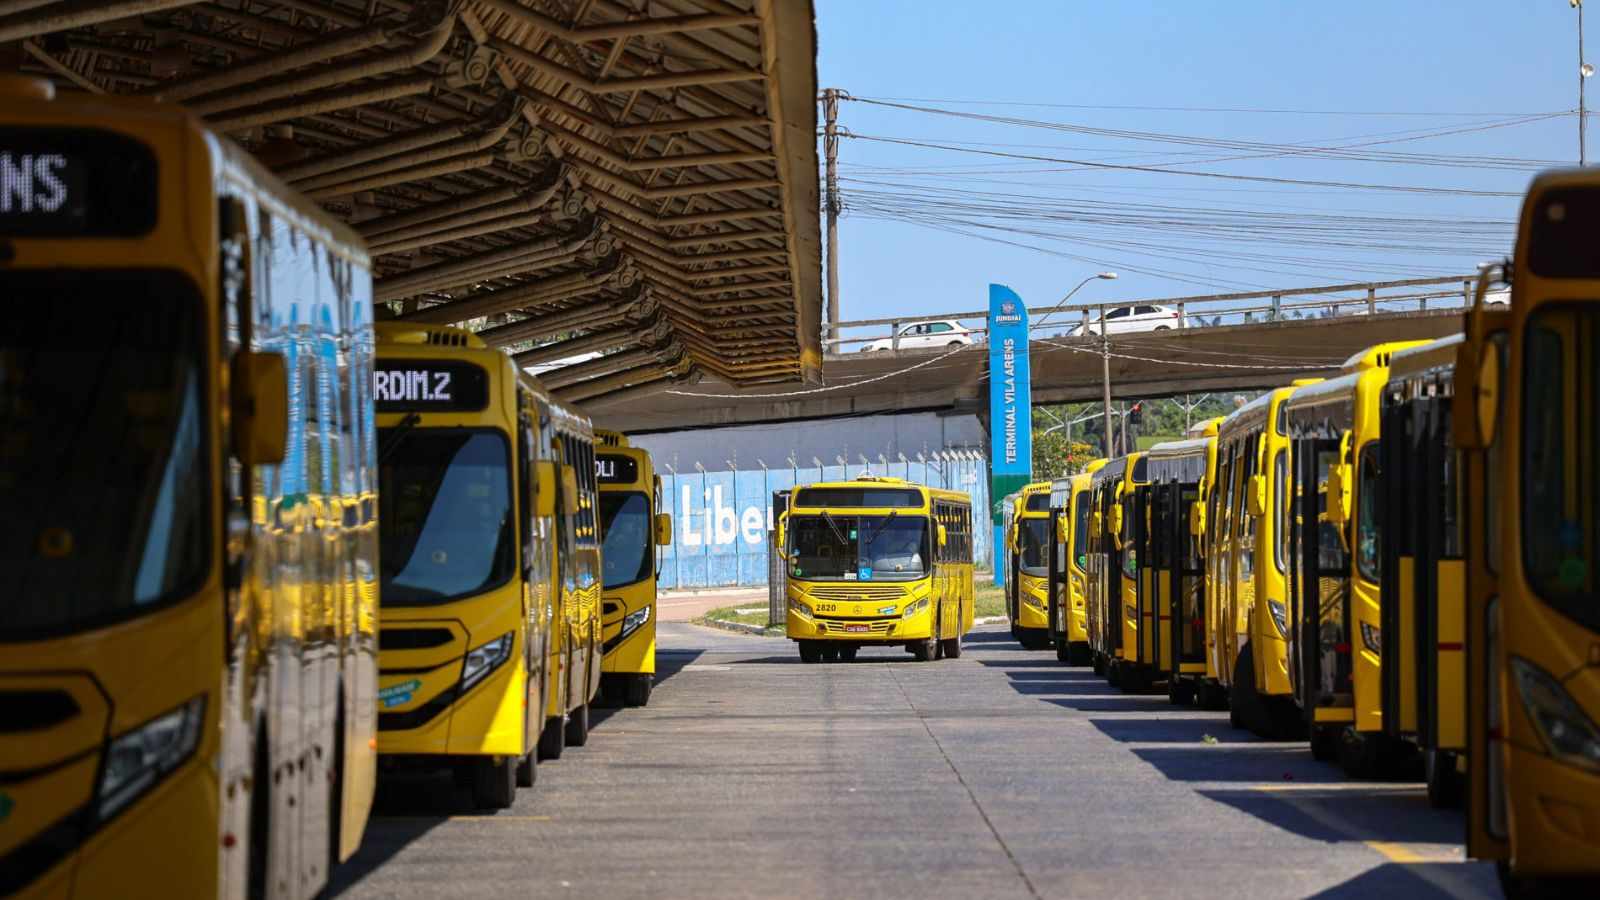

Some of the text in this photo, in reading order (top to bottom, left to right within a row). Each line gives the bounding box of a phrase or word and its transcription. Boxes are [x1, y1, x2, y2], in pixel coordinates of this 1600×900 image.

[0, 154, 66, 212] NS
[1003, 338, 1017, 464] TERMINAL VILA ARENS
[816, 604, 837, 612] 2820
